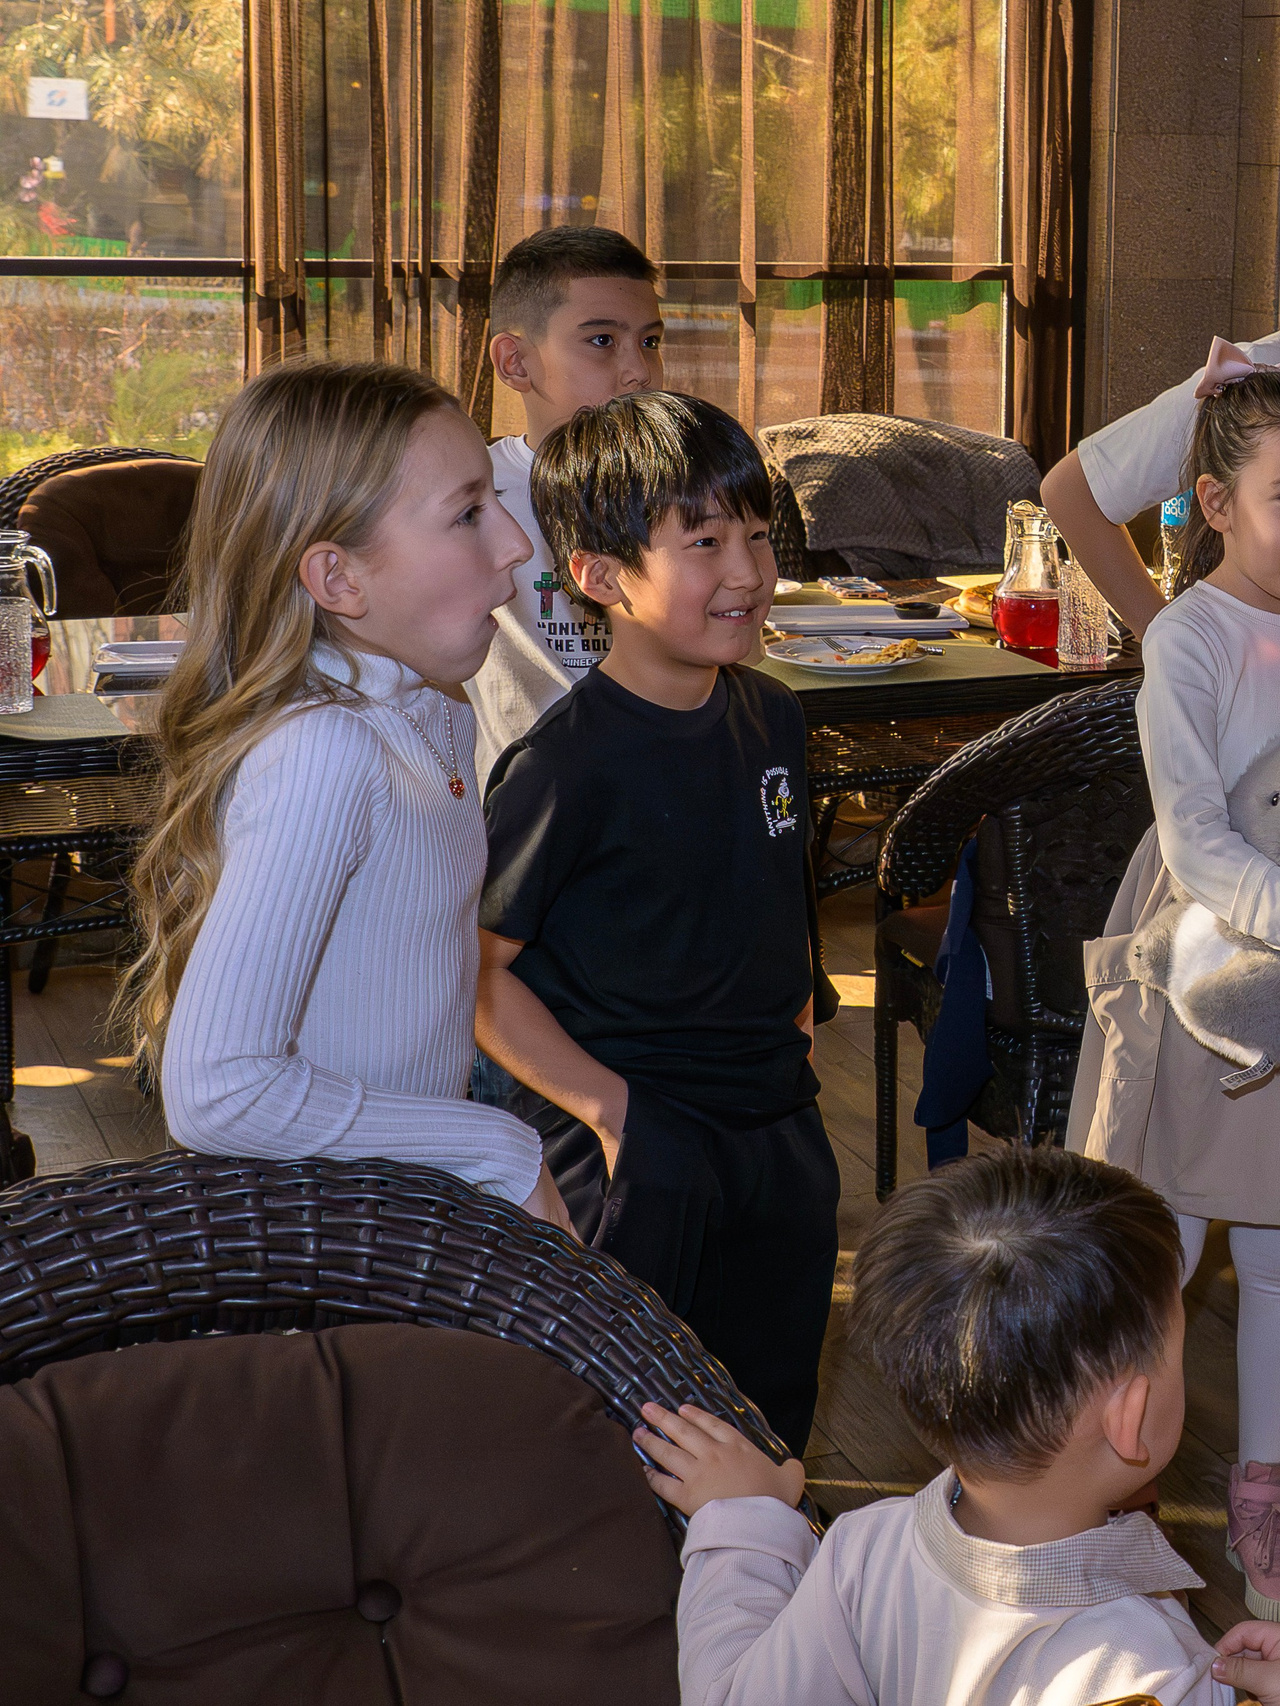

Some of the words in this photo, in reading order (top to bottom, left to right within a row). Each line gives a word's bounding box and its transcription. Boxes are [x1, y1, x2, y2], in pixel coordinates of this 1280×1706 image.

[898, 231, 958, 252] Alma
[545, 637, 575, 652] THE
[581, 638, 611, 652] BOL
[765, 766, 789, 780] POSSIBLE
[761, 775, 769, 787] IS
[760, 787, 777, 838] ANYTHING
